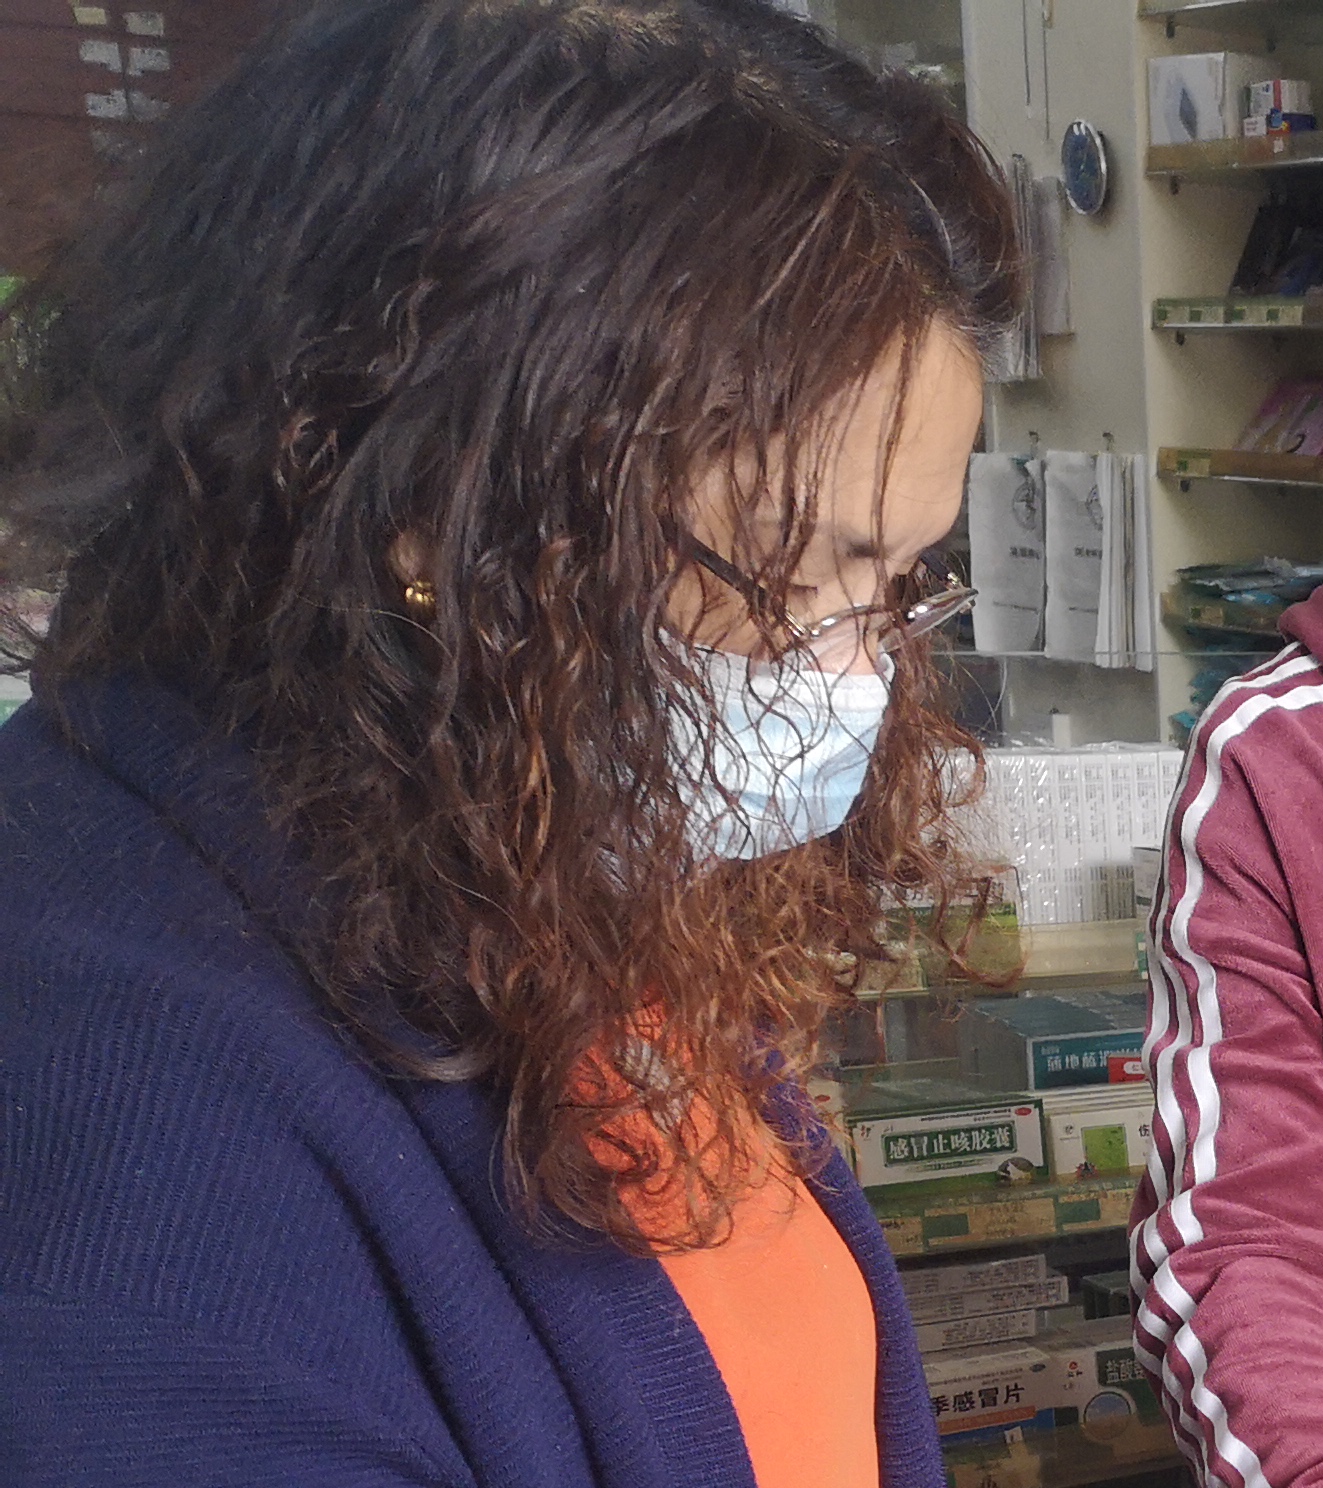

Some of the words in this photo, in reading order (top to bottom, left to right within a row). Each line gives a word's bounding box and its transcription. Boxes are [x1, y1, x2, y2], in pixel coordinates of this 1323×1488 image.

[888, 1127, 1011, 1161] 感冒止咳胶囊
